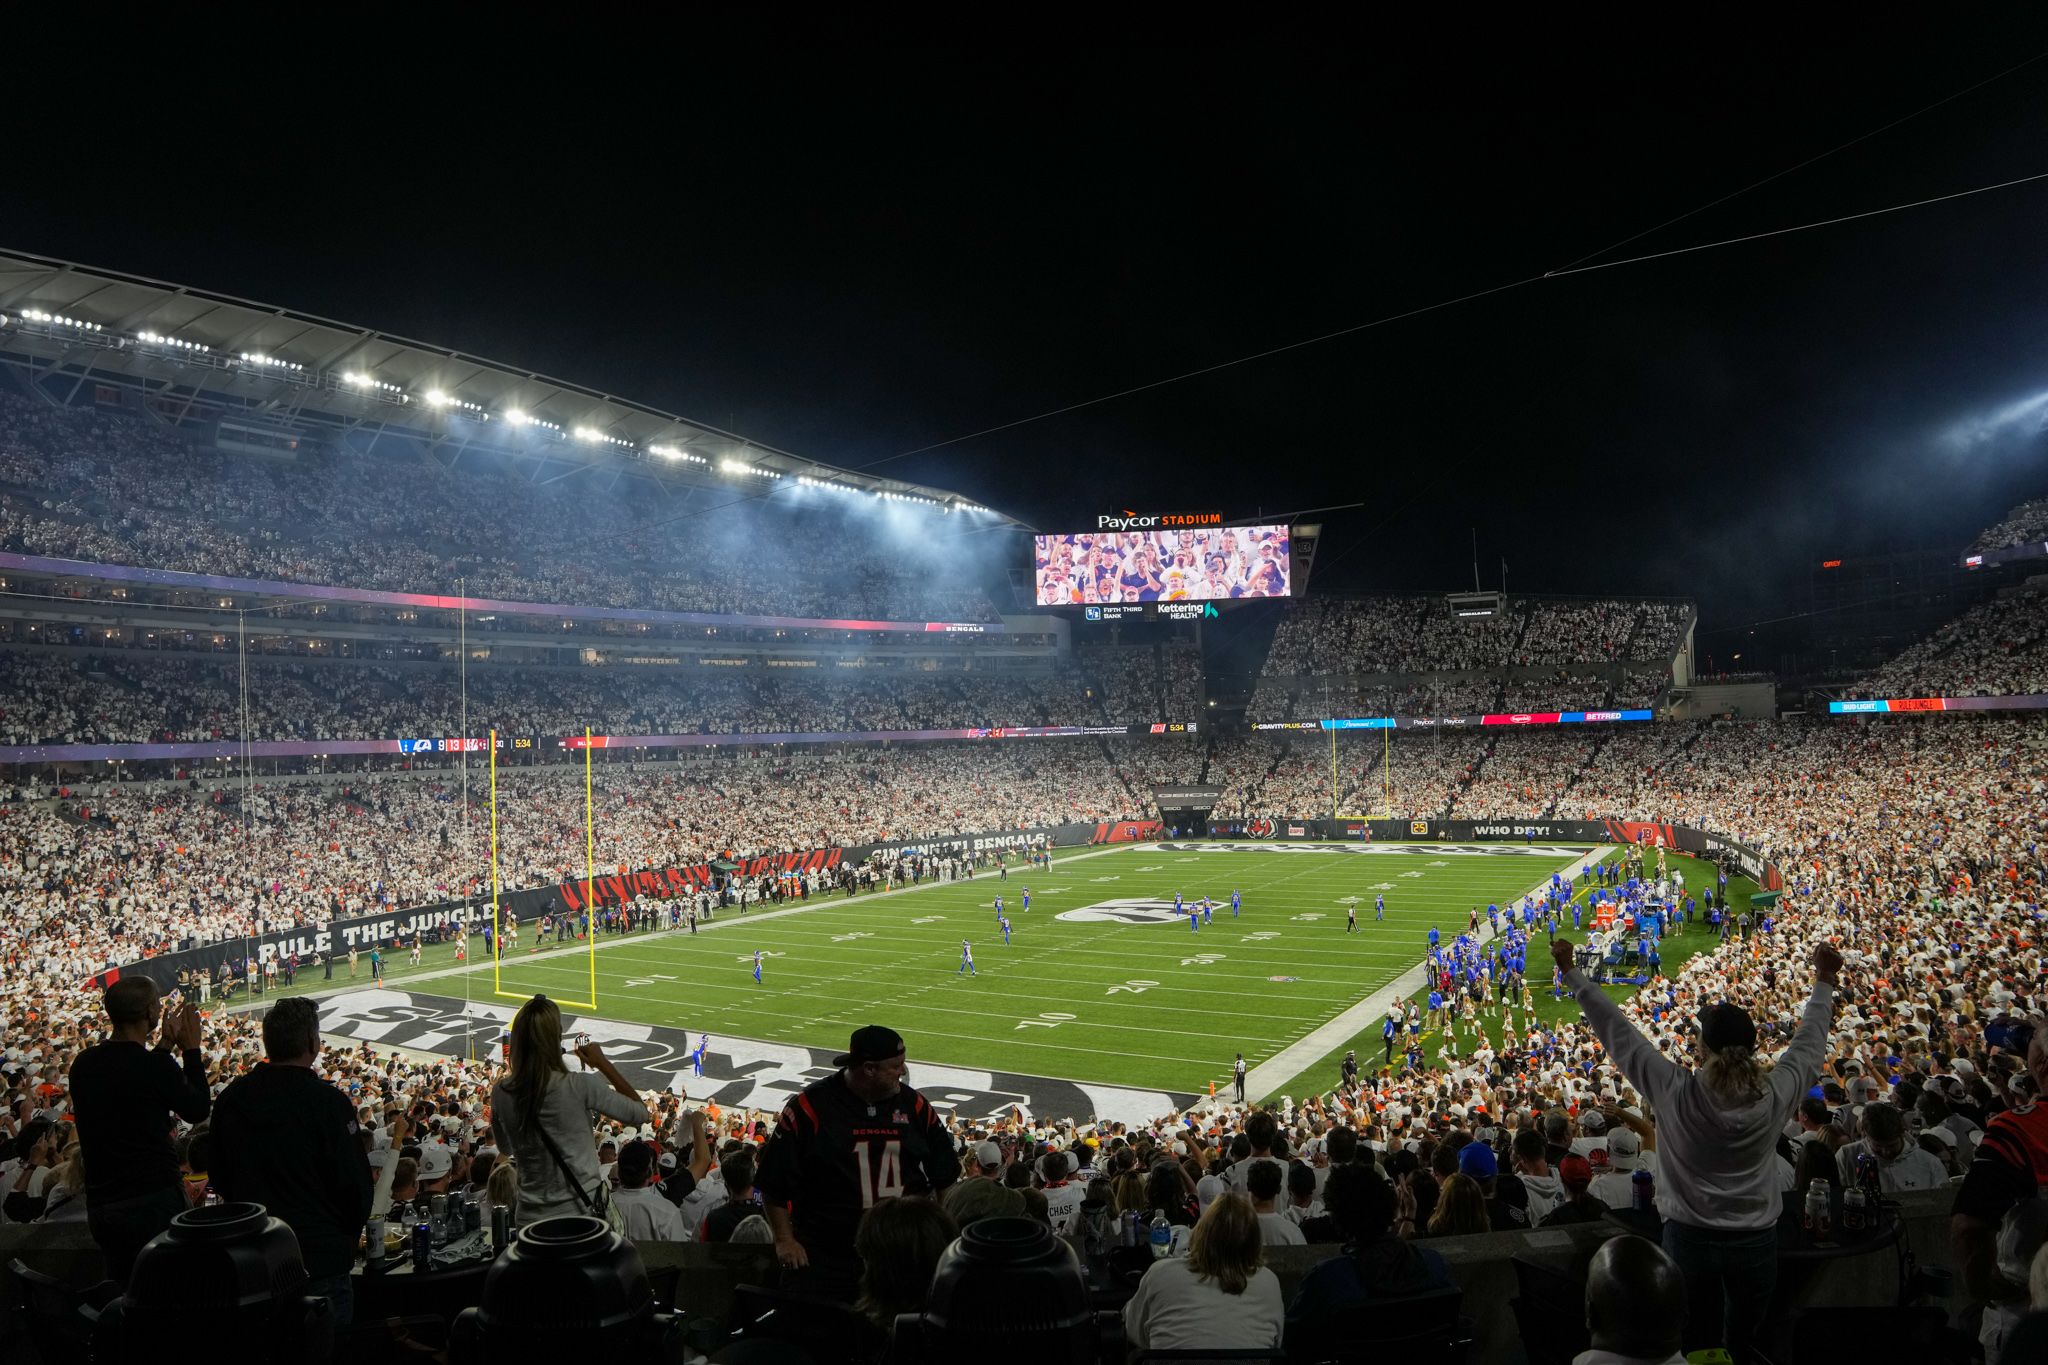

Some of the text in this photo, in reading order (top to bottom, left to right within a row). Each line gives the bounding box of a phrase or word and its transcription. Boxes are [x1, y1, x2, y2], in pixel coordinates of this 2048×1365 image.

[1098, 512, 1221, 531] Paycor STADIUM
[1158, 603, 1203, 614] Kettering
[1170, 612, 1197, 620] HEALTH
[1857, 702, 1875, 710] LIGHT
[1443, 717, 1466, 726] Paycor
[1586, 712, 1622, 721] BETFRED
[1413, 718, 1435, 727] Paycor
[1169, 724, 1184, 732] 5:34
[438, 740, 445, 751] 9
[449, 739, 459, 750] 13
[515, 739, 531, 748] 5:34
[1413, 823, 1425, 833] 25
[1474, 826, 1511, 835] WHO
[974, 832, 1045, 851] BENGALS
[258, 902, 500, 965] RULE THE JUNGLE
[1105, 980, 1160, 996] 20
[1013, 1012, 1078, 1030] 10
[852, 1128, 899, 1136] BENGALS
[853, 1140, 905, 1209] 14
[1049, 1204, 1073, 1217] CHASE
